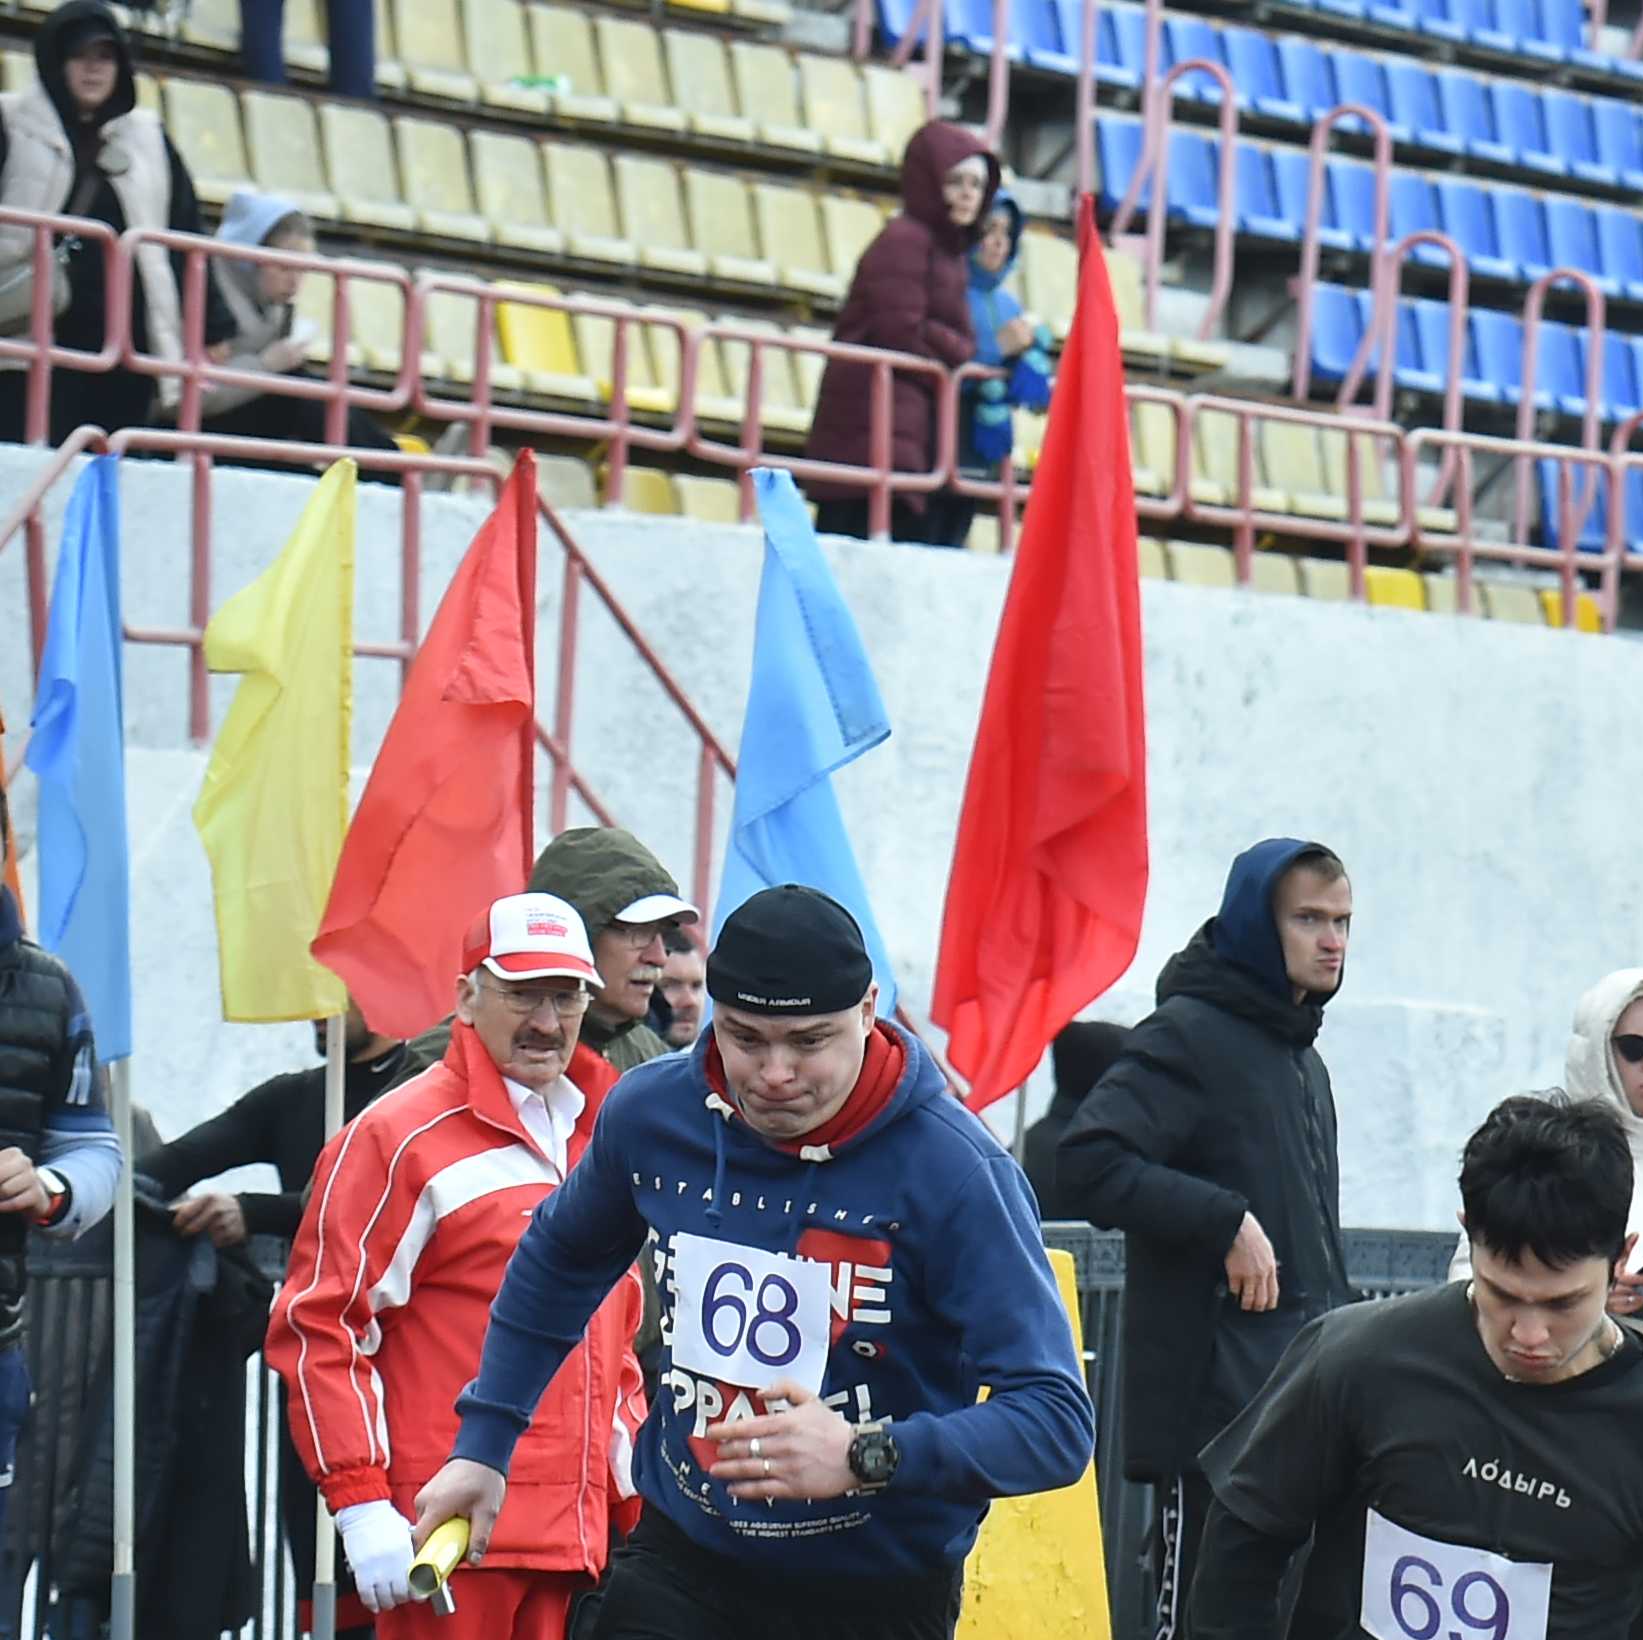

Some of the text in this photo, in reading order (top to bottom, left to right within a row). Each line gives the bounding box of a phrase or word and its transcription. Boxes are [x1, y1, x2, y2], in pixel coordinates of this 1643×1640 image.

[738, 992, 811, 1007] UNDER ARMOUR
[701, 1261, 802, 1368] 68
